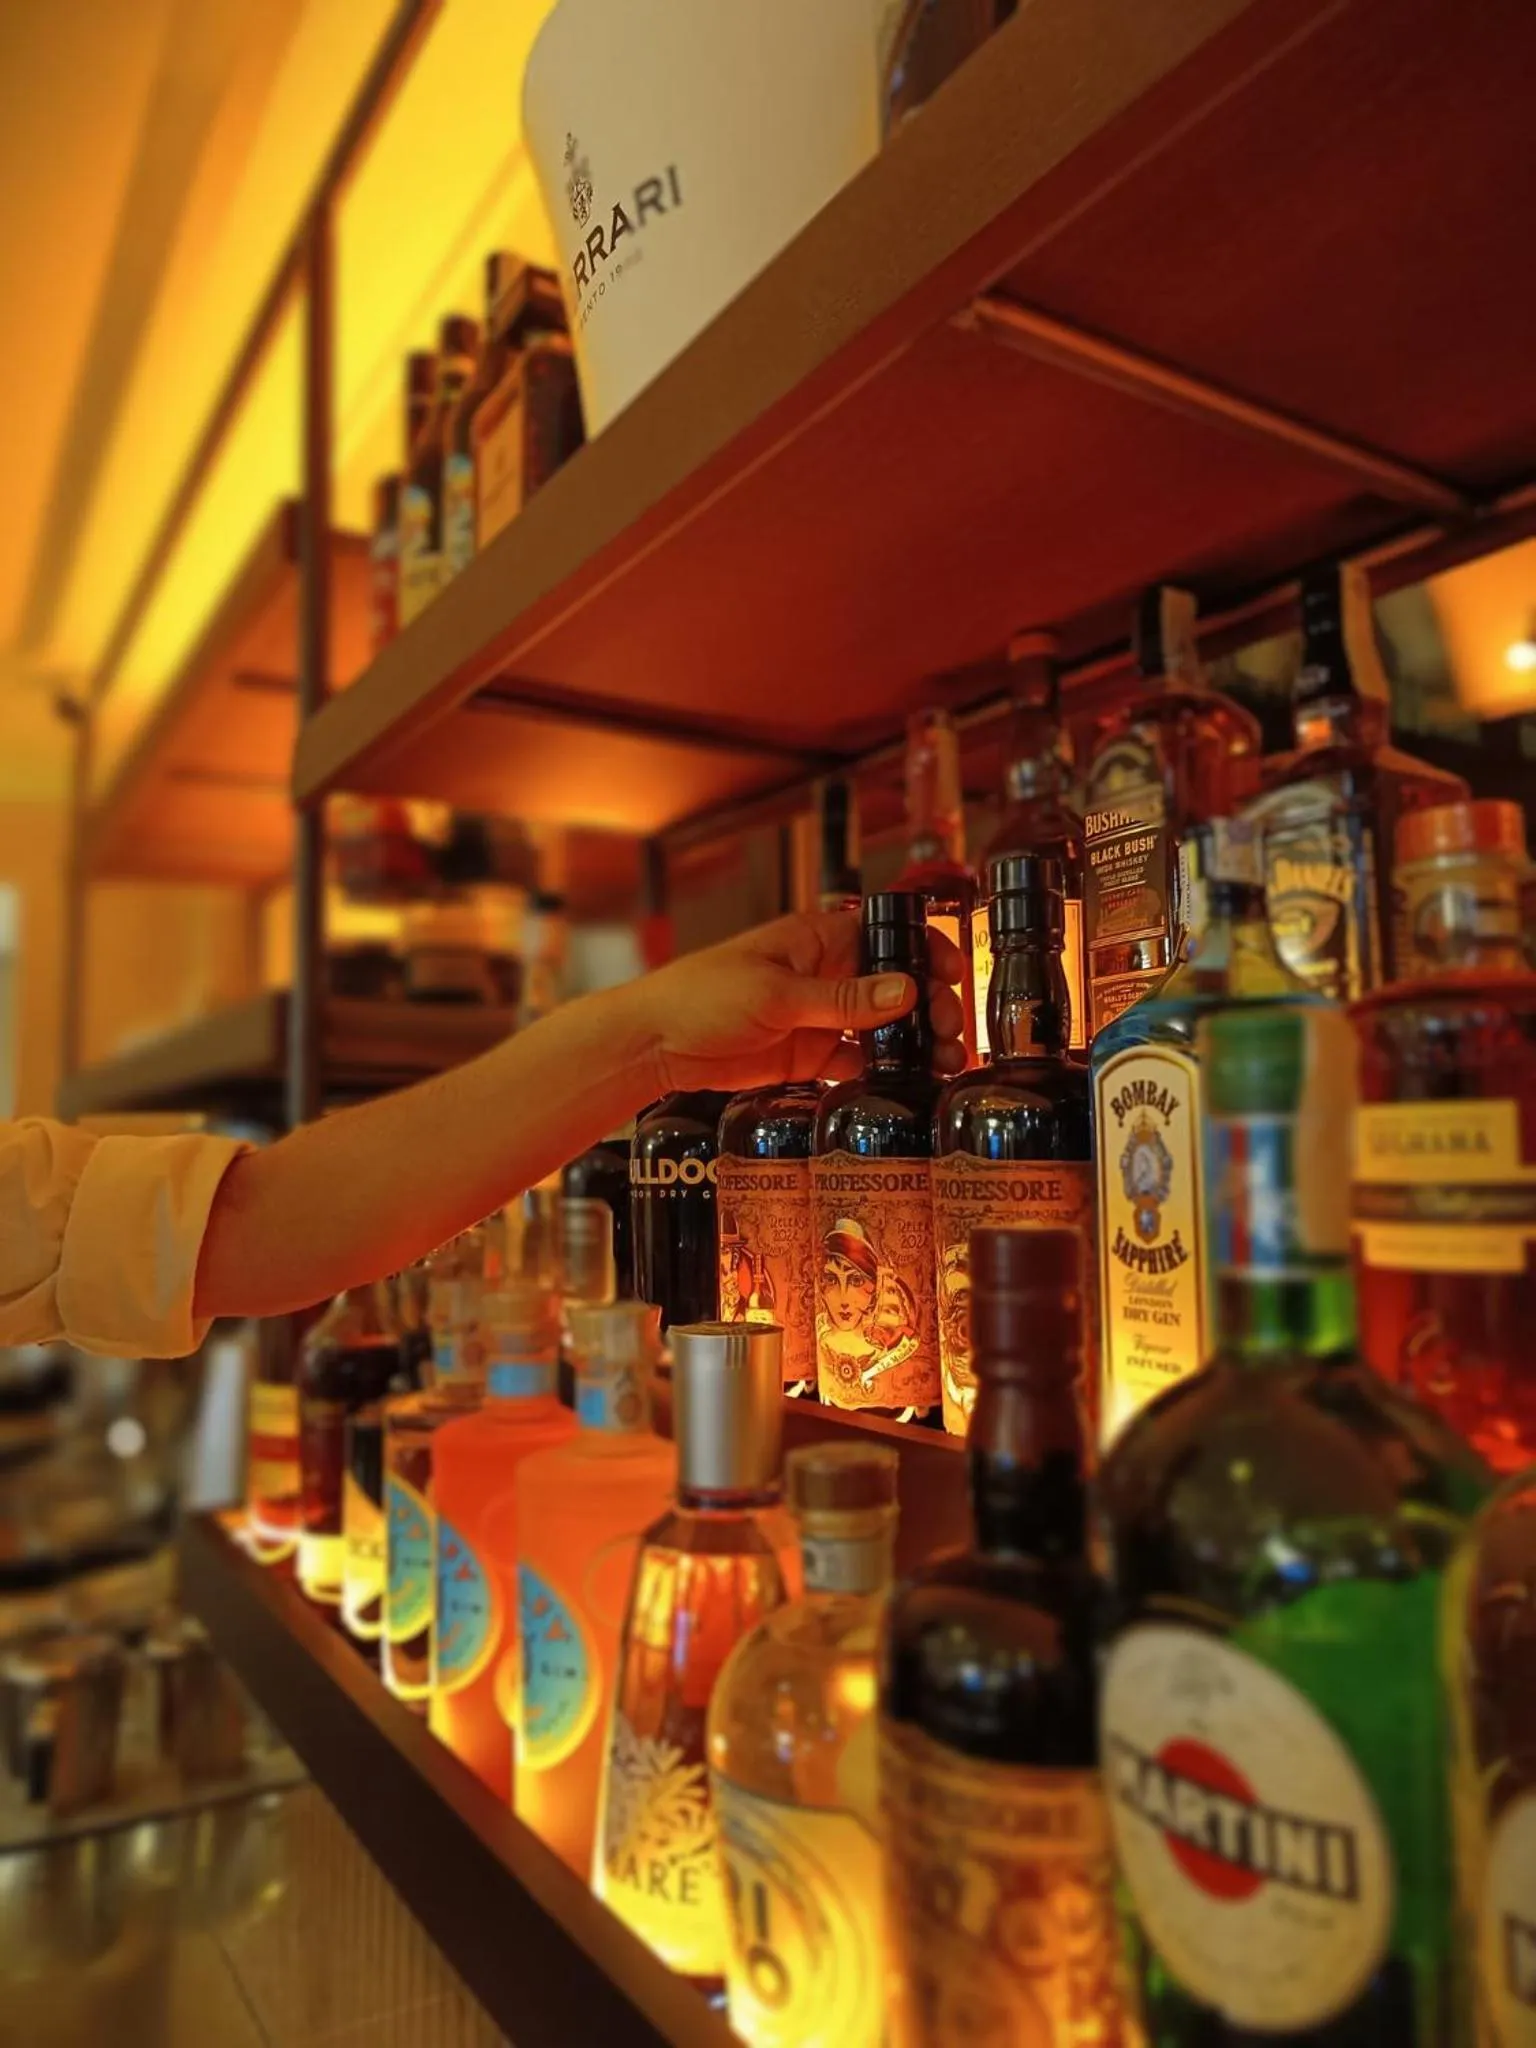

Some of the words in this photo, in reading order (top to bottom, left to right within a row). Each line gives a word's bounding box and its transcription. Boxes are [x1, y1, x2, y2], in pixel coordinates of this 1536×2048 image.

[1085, 811, 1135, 838] BUSHM
[1090, 844, 1121, 866] BLACK
[1124, 835, 1155, 856] BUSH
[1110, 1079, 1181, 1121] BOMBAY
[660, 1189, 688, 1199] DRY
[1111, 1231, 1190, 1276] SAPPHIRE
[1122, 1306, 1149, 1323] DRY
[1152, 1310, 1182, 1327] GIN
[1106, 1736, 1363, 1905] MARTINI
